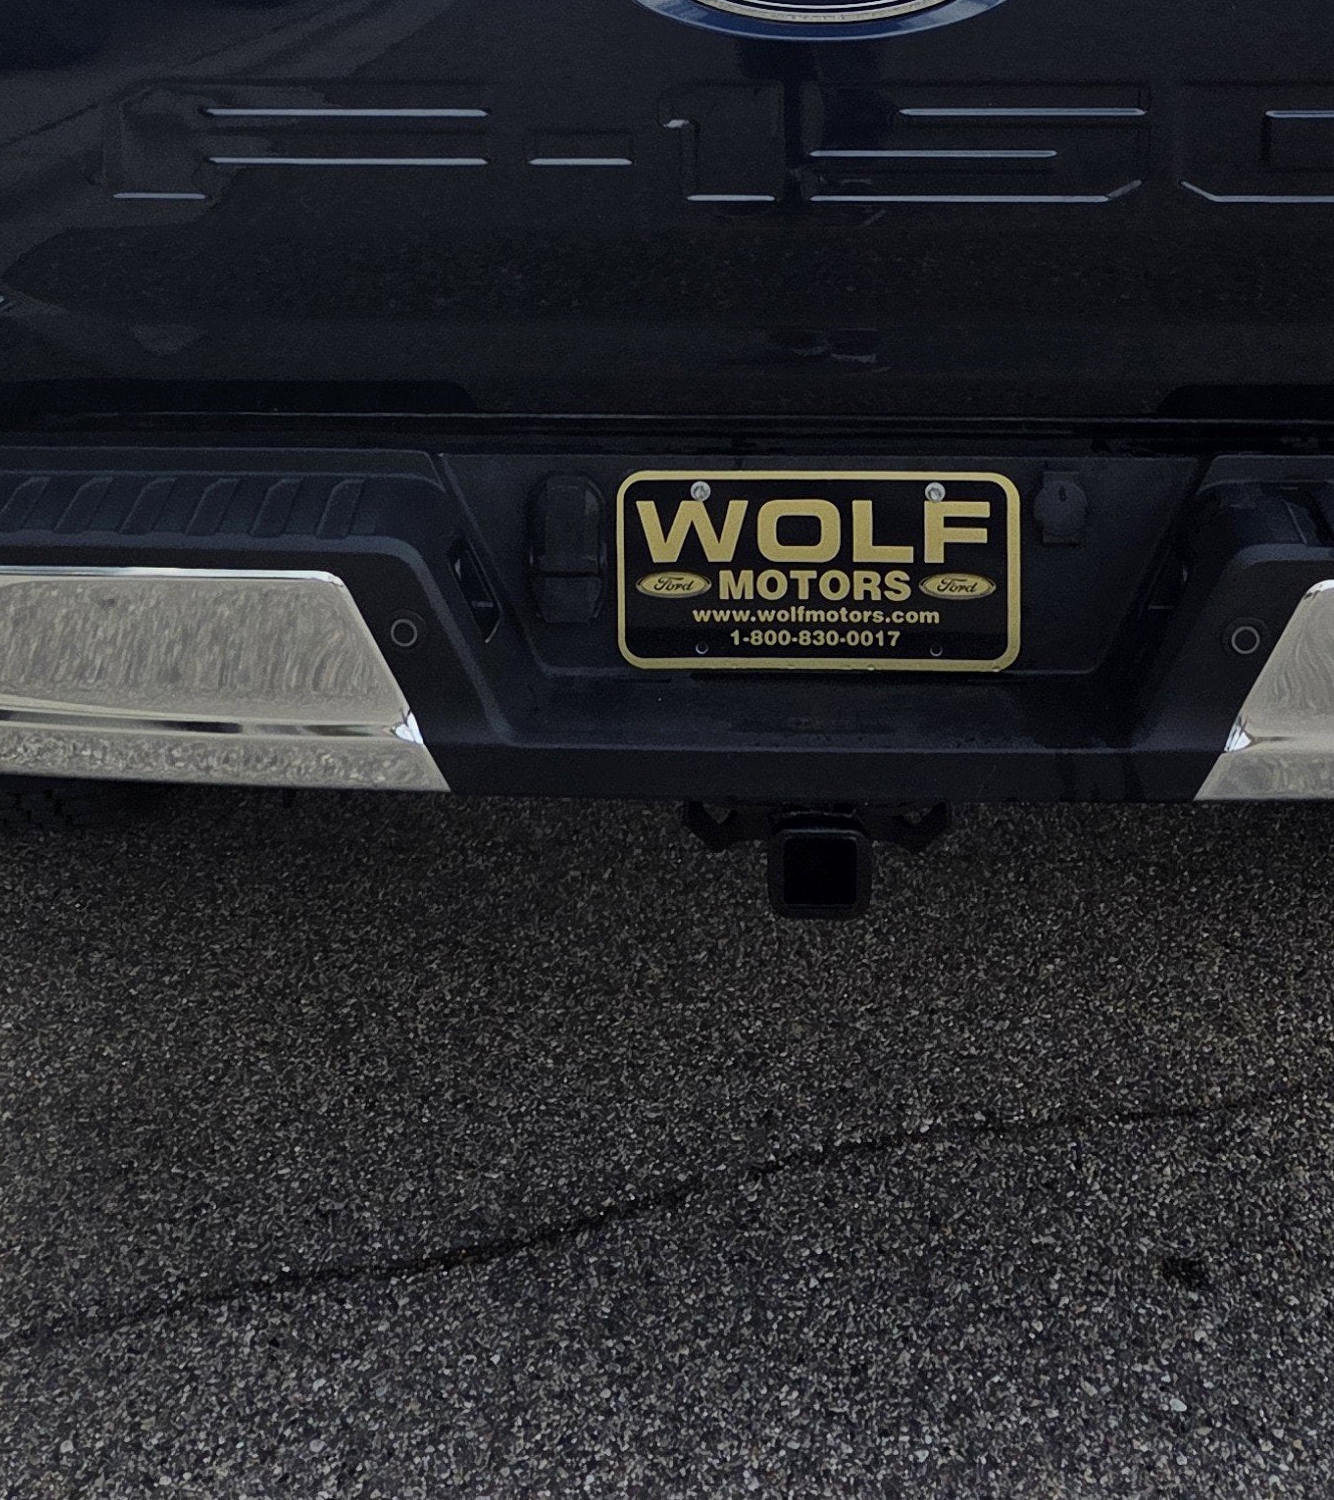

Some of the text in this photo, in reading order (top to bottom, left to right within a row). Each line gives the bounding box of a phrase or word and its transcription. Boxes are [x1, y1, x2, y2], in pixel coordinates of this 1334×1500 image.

[635, 499, 991, 564] WOLF
[653, 574, 695, 593] Ford
[718, 569, 912, 602] MOTORS
[935, 574, 979, 595] Ford
[692, 605, 941, 625] www.wolfmotors.com
[730, 629, 902, 648] 1-800-830-0017
